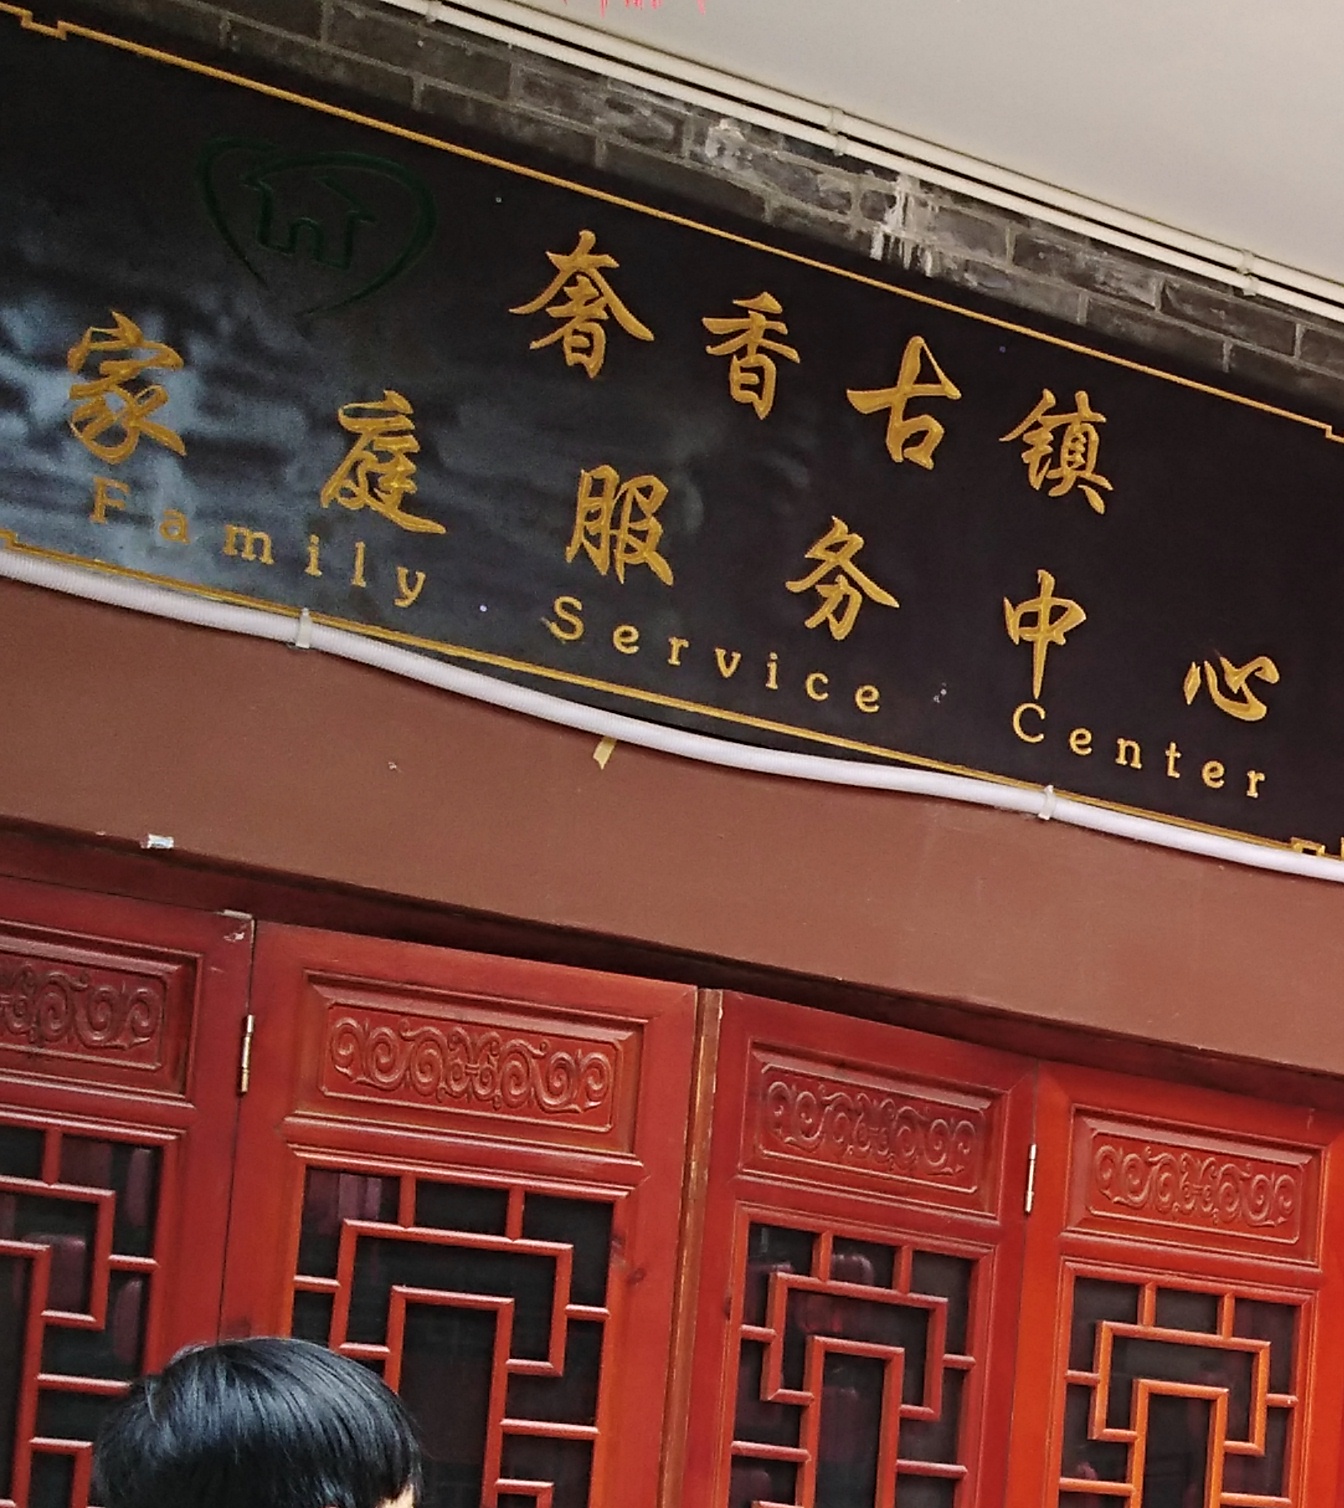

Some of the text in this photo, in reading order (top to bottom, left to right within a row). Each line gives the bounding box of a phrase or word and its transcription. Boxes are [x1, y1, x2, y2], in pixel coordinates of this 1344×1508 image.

[67, 311, 1281, 722] 家庭服务中心
[509, 230, 1113, 514] 奢香古镇
[92, 477, 1267, 799] Family Service Center
